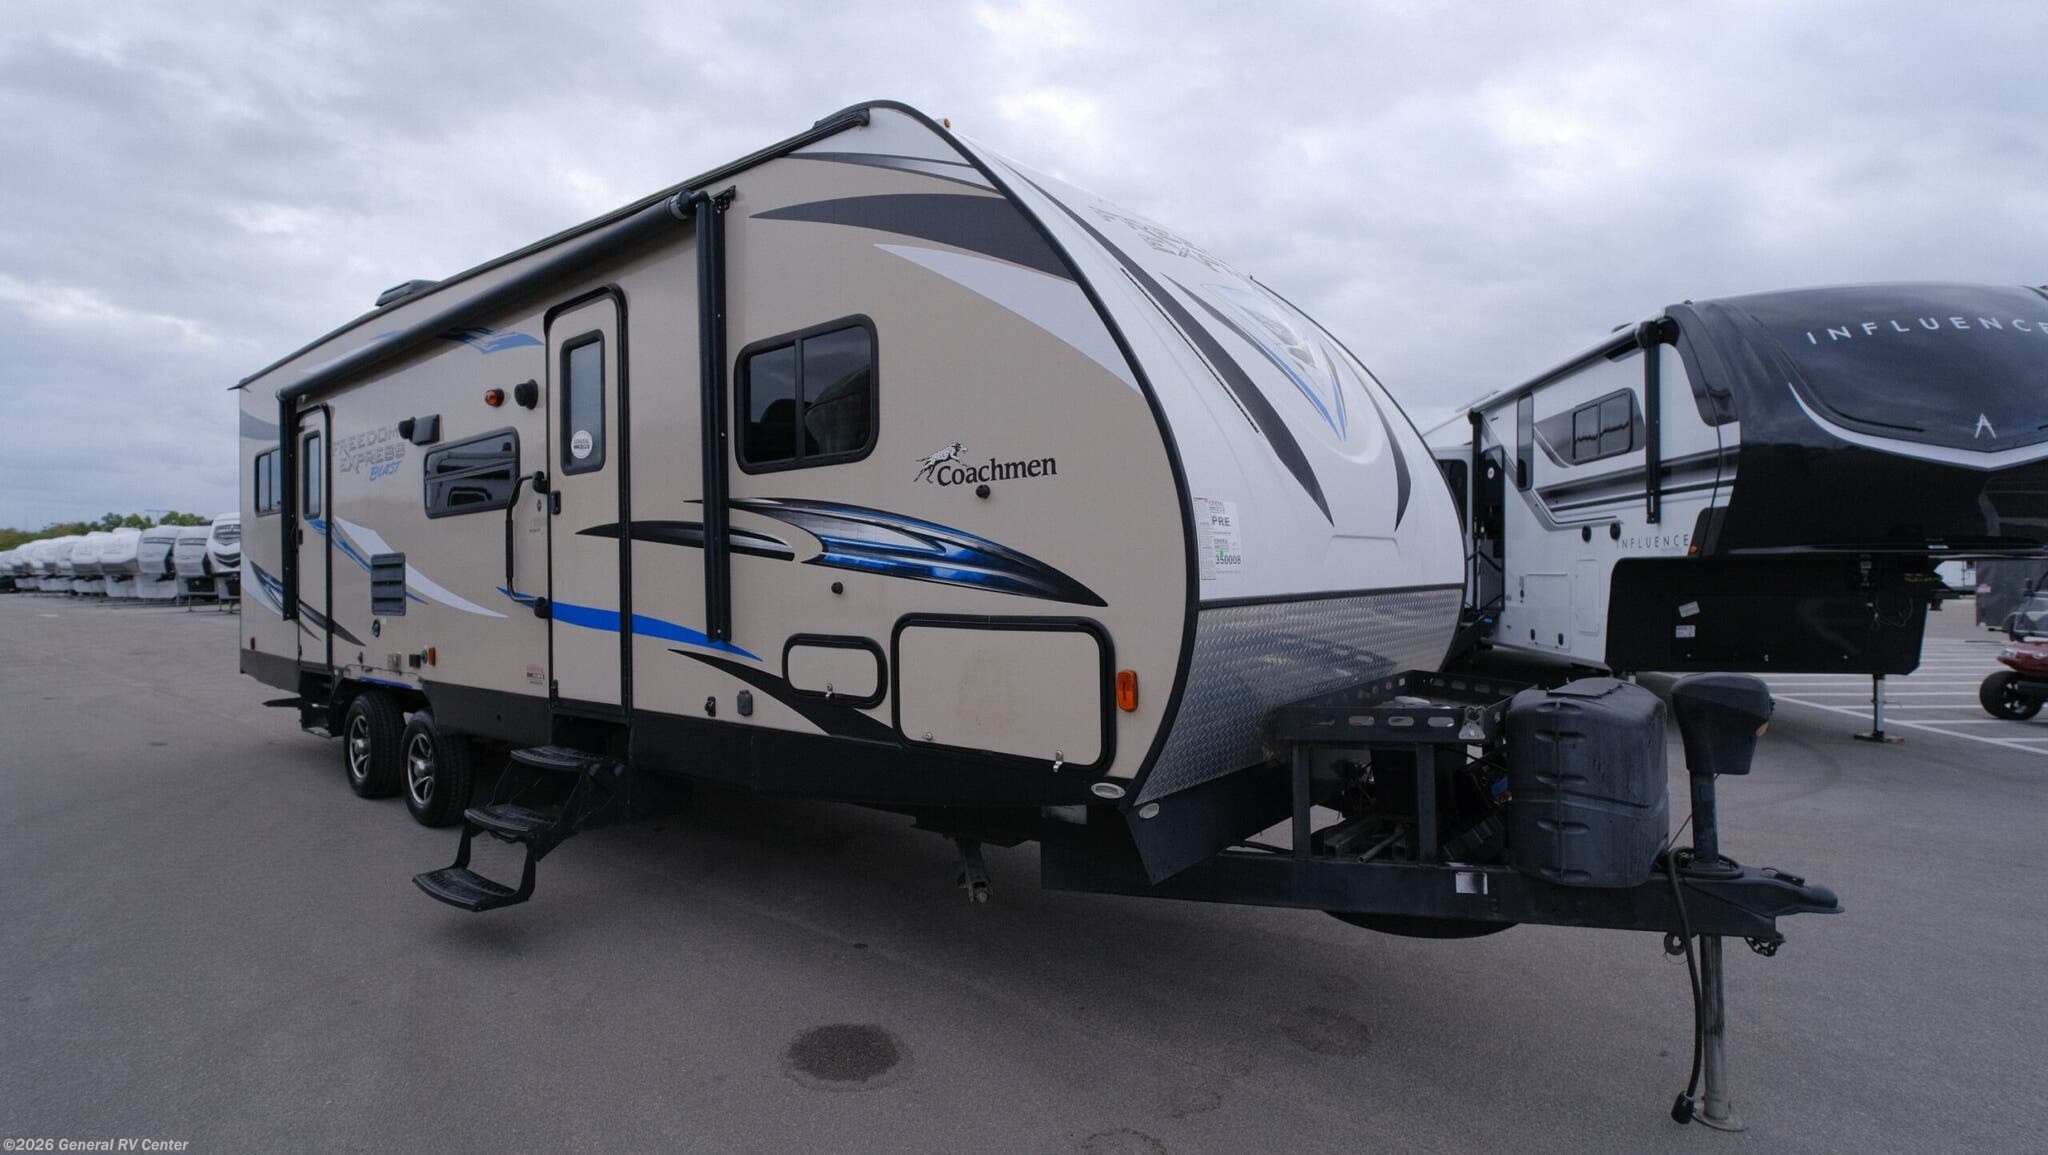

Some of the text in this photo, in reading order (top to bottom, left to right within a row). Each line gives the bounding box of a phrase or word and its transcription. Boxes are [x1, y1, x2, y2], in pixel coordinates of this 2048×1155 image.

[339, 441, 406, 474] EXPRESS
[937, 456, 1057, 487] Coachmen
[1211, 516, 1231, 527] PRE
